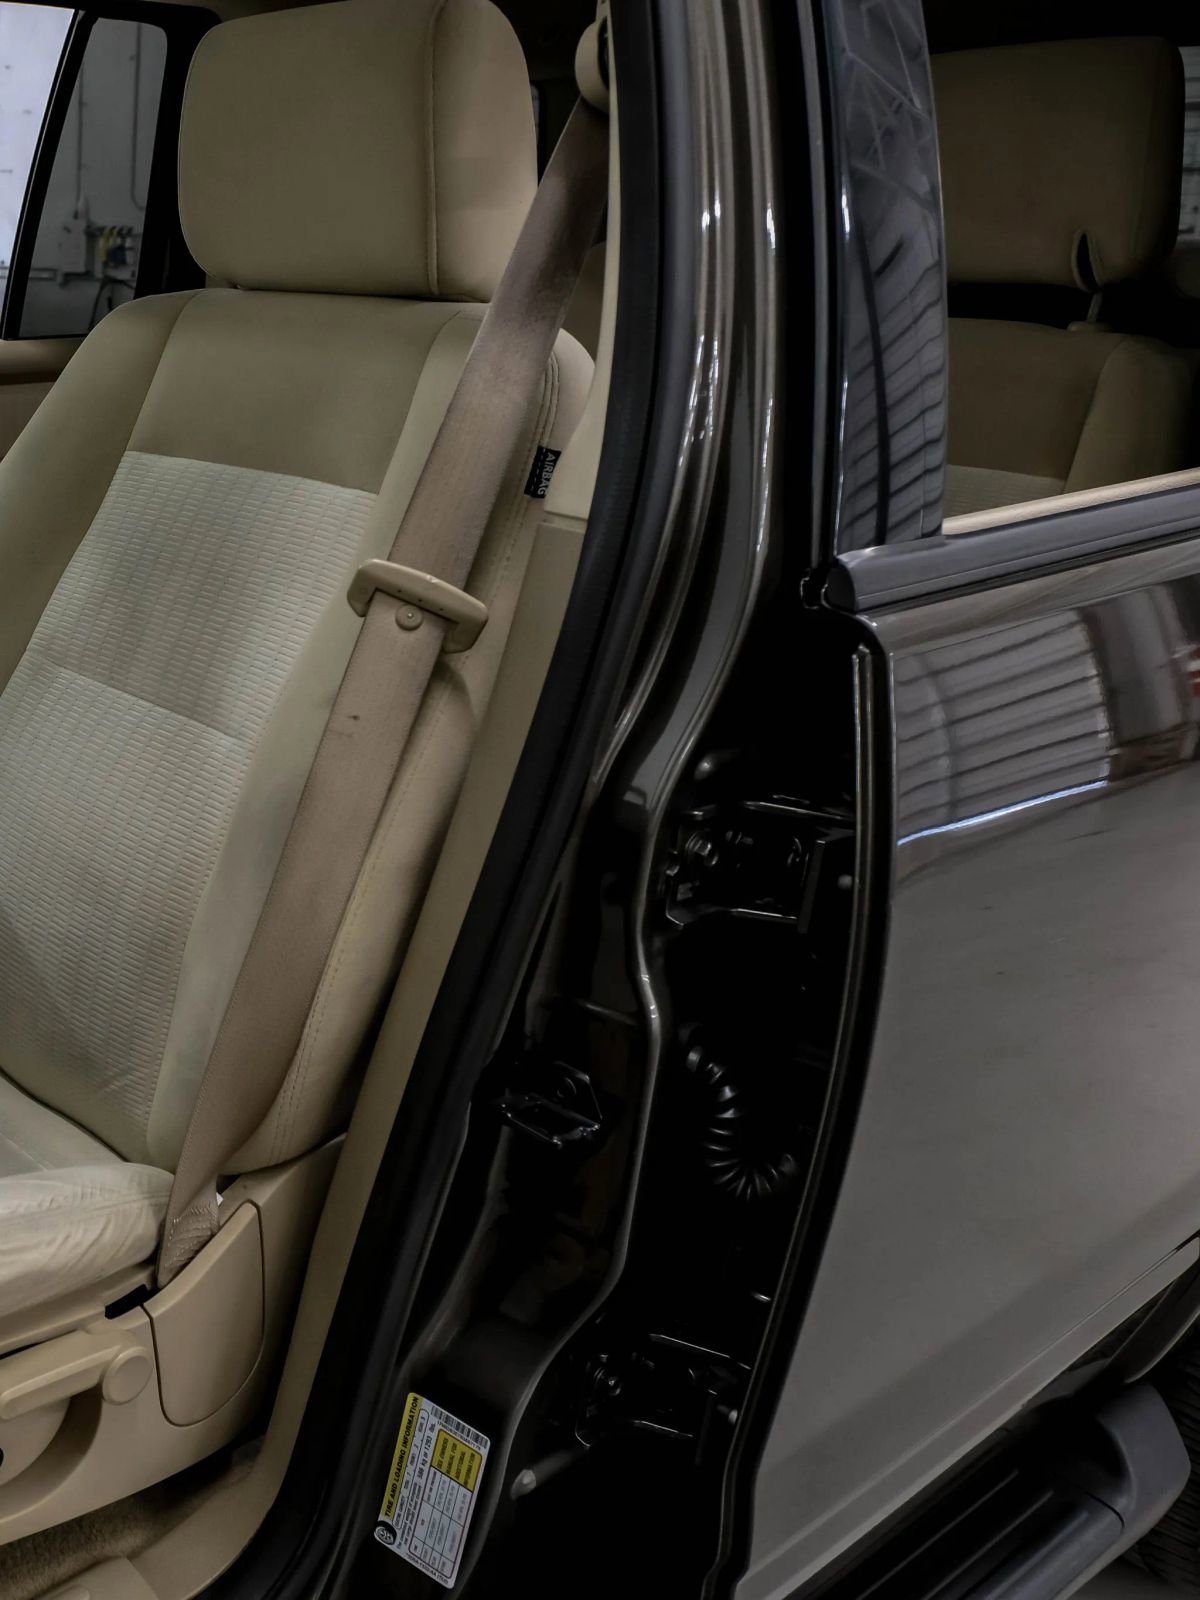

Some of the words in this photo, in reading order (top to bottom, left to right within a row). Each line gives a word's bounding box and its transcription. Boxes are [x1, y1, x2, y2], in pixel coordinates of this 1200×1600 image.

[537, 452, 557, 495] AIRBAG
[384, 1499, 393, 1517] TIRE
[394, 1449, 406, 1483] LOADING
[401, 1396, 419, 1449] INFORMATION
